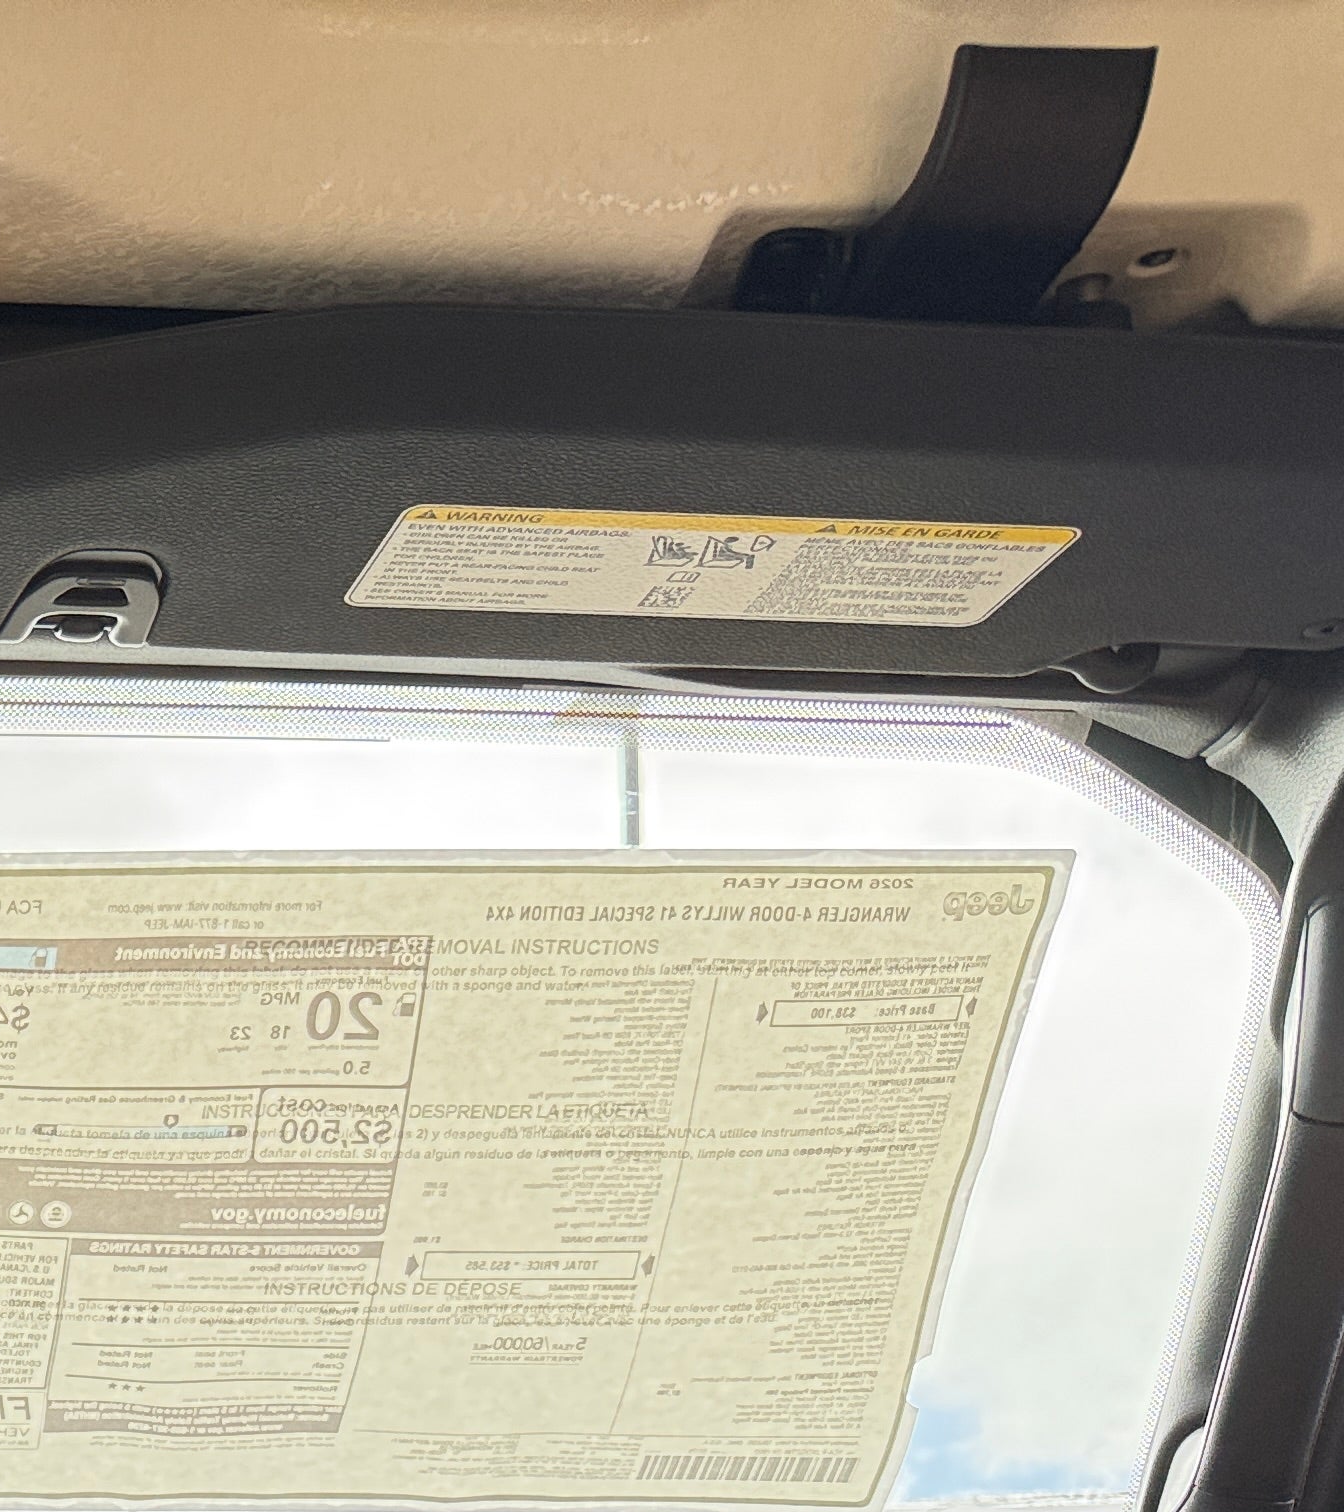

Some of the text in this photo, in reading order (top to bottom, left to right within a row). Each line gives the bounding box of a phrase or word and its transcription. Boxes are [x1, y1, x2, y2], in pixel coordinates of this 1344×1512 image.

[446, 510, 545, 524] WARNING
[848, 525, 1004, 540] MISE EN GARDE
[511, 938, 659, 955] INSTRUCTIONS
[432, 966, 467, 977] other
[470, 965, 508, 978] sharp
[562, 966, 577, 976] To
[580, 967, 629, 977] remove
[632, 965, 656, 976] this
[408, 1104, 532, 1119] DESPRENDER
[263, 1282, 406, 1297] INSTRUCTIONS
[412, 1283, 438, 1296] DE
[444, 1279, 522, 1296] DÉPOSE
